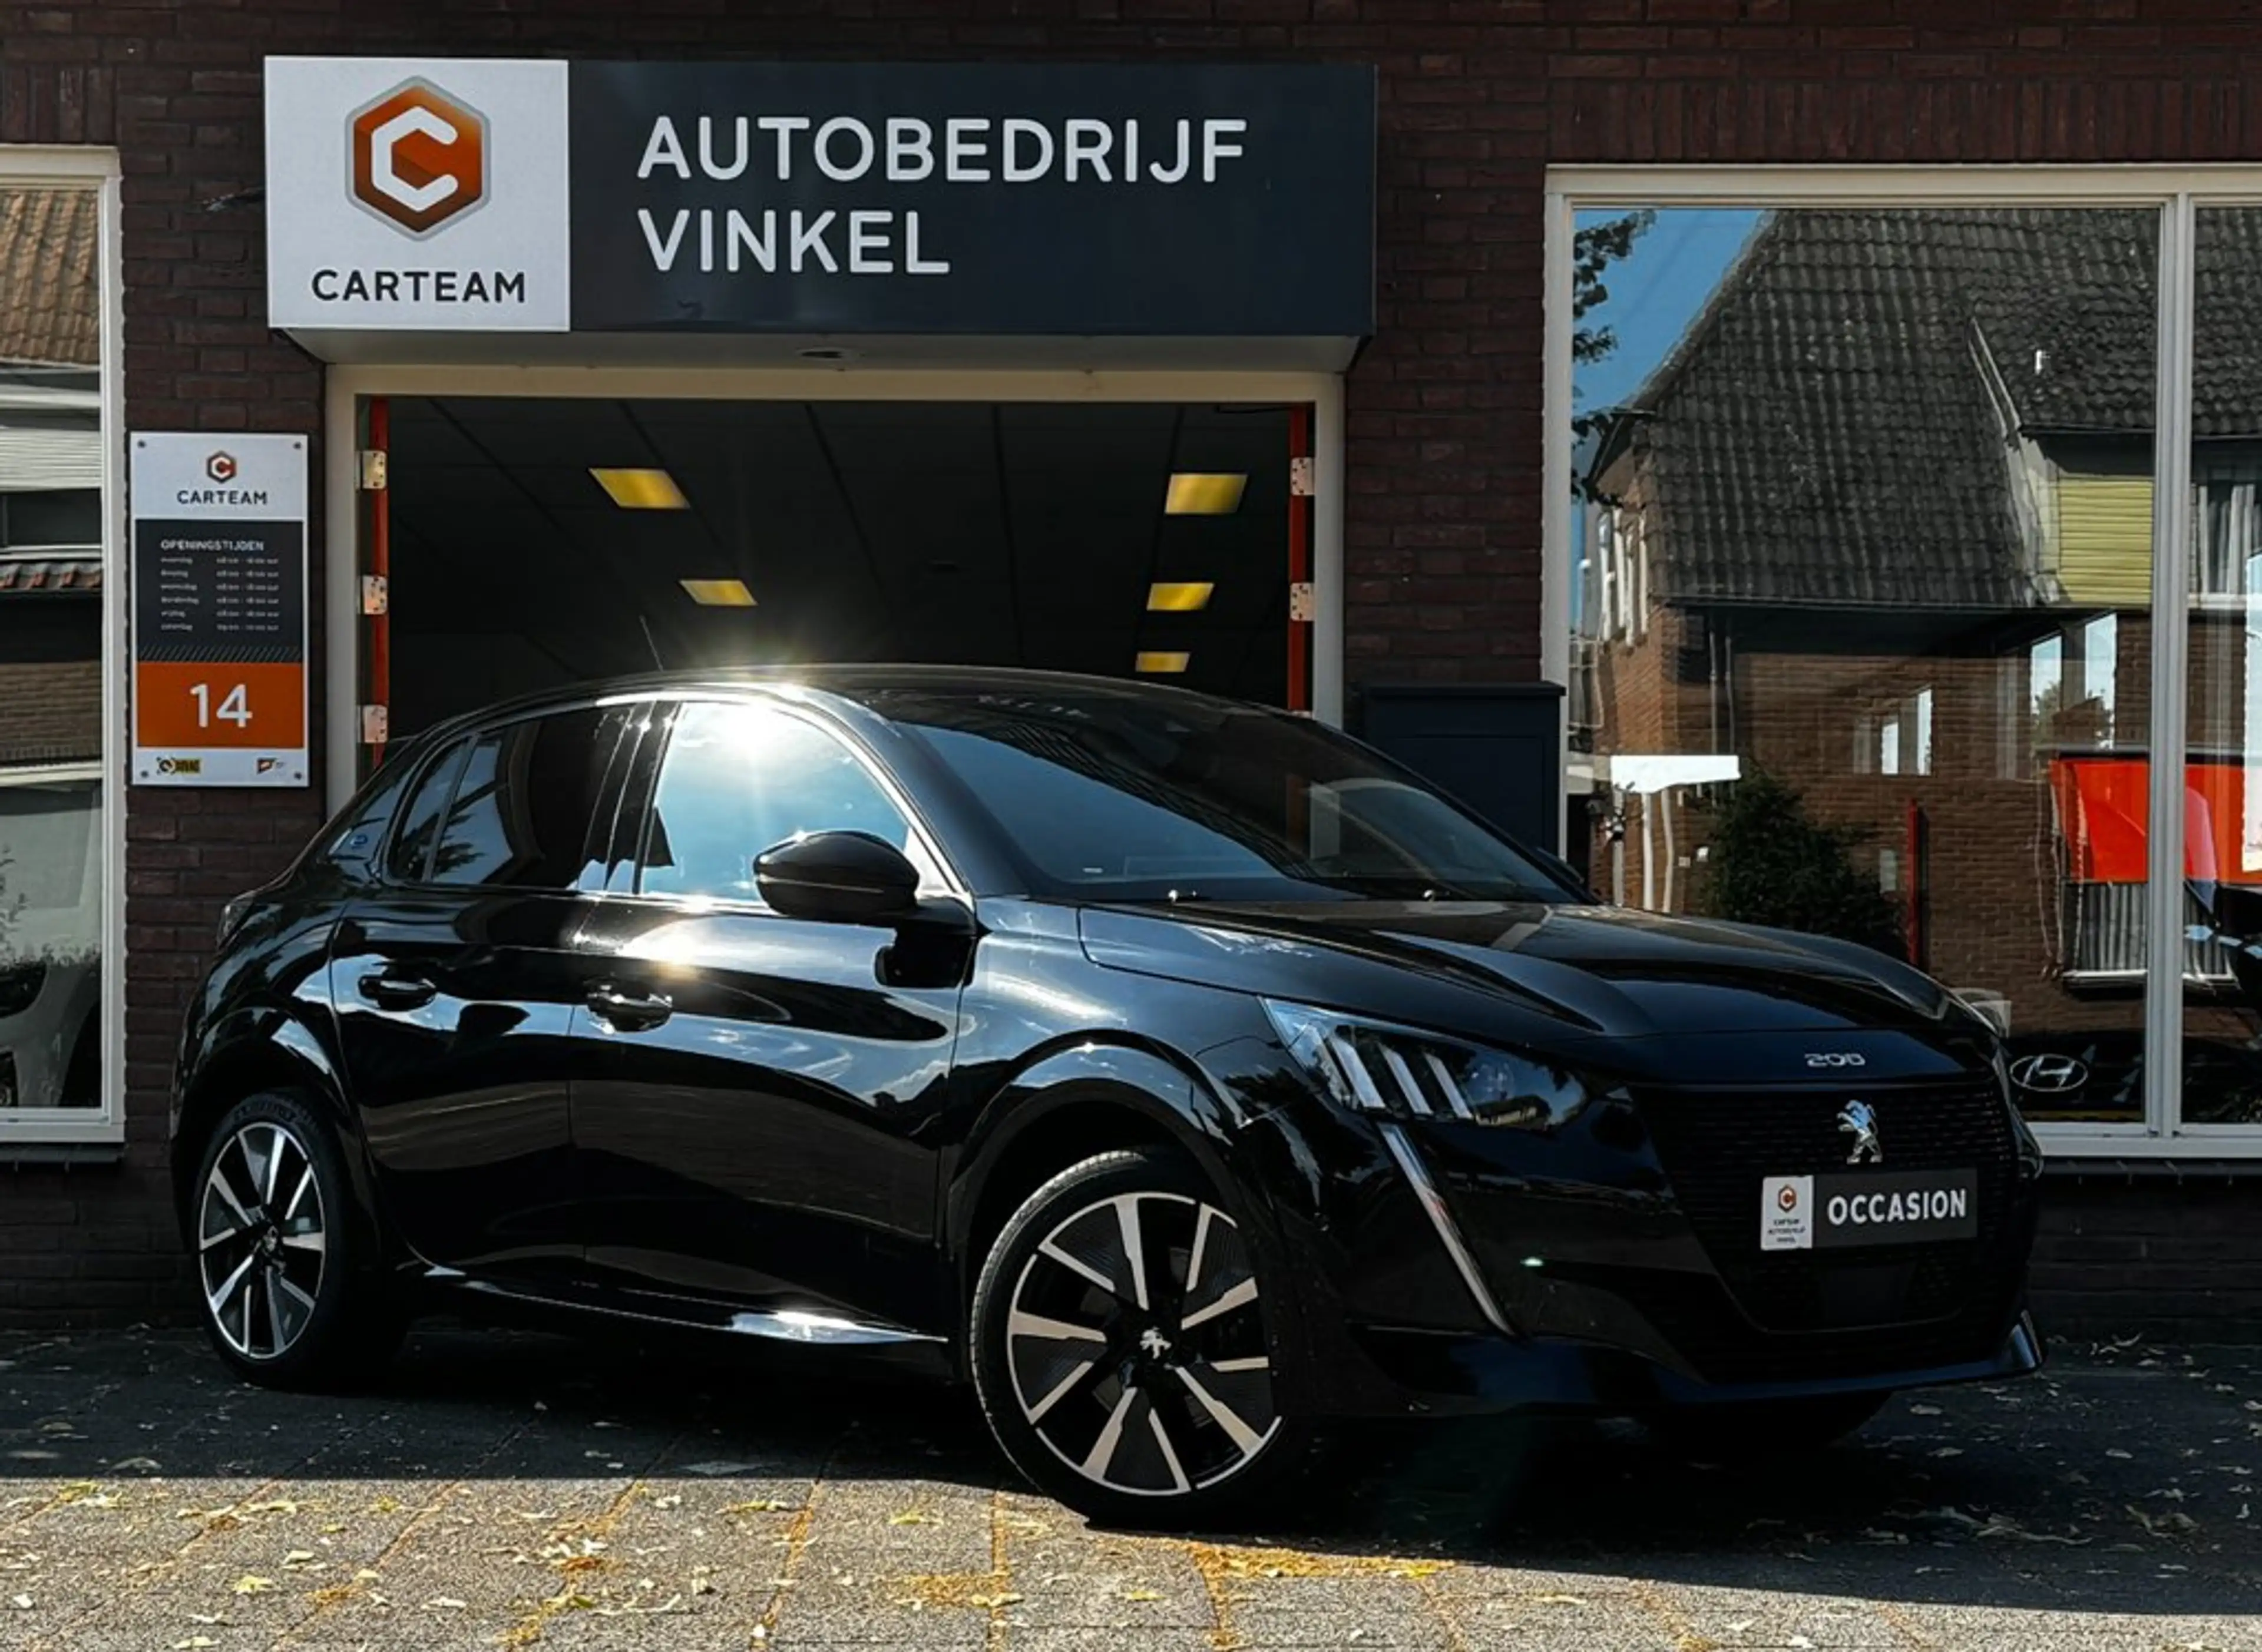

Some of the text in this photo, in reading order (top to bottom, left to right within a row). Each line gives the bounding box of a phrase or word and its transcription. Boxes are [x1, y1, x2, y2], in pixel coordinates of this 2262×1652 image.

[637, 116, 1247, 183] AUTOBEDRIJF
[637, 209, 950, 274] VINKEL
[311, 269, 525, 304] CARTEAM
[177, 490, 268, 505] CARTEAM
[160, 539, 264, 551] OPENINGSTIJDEN
[190, 683, 253, 728] 14
[1828, 1188, 1967, 1226] OCCASION
